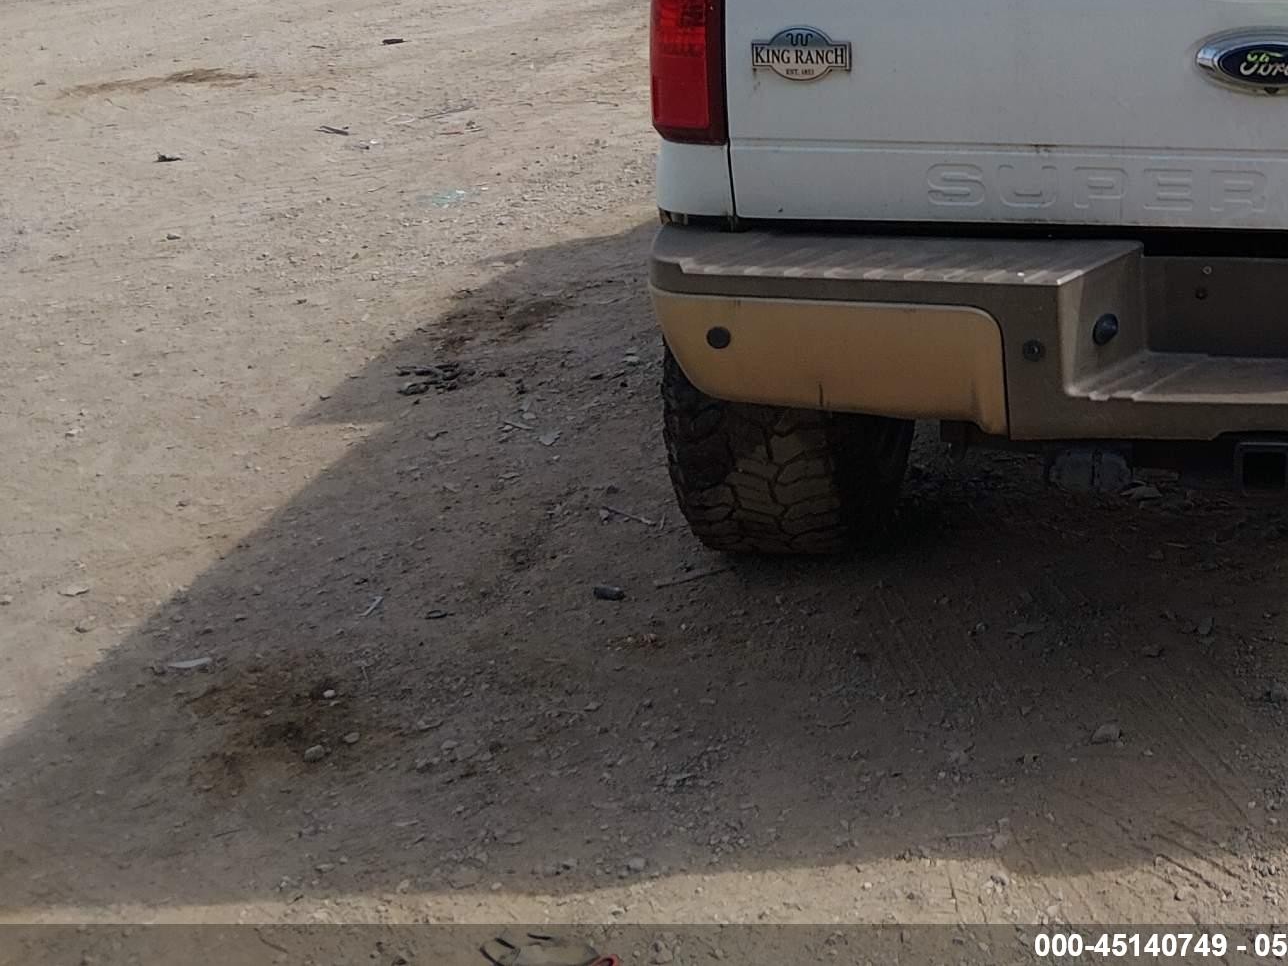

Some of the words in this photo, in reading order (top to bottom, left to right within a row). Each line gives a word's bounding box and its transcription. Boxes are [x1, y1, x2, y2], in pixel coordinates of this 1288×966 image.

[755, 46, 790, 64] KING
[795, 47, 844, 65] RANCH
[926, 163, 1267, 212] SUPER
